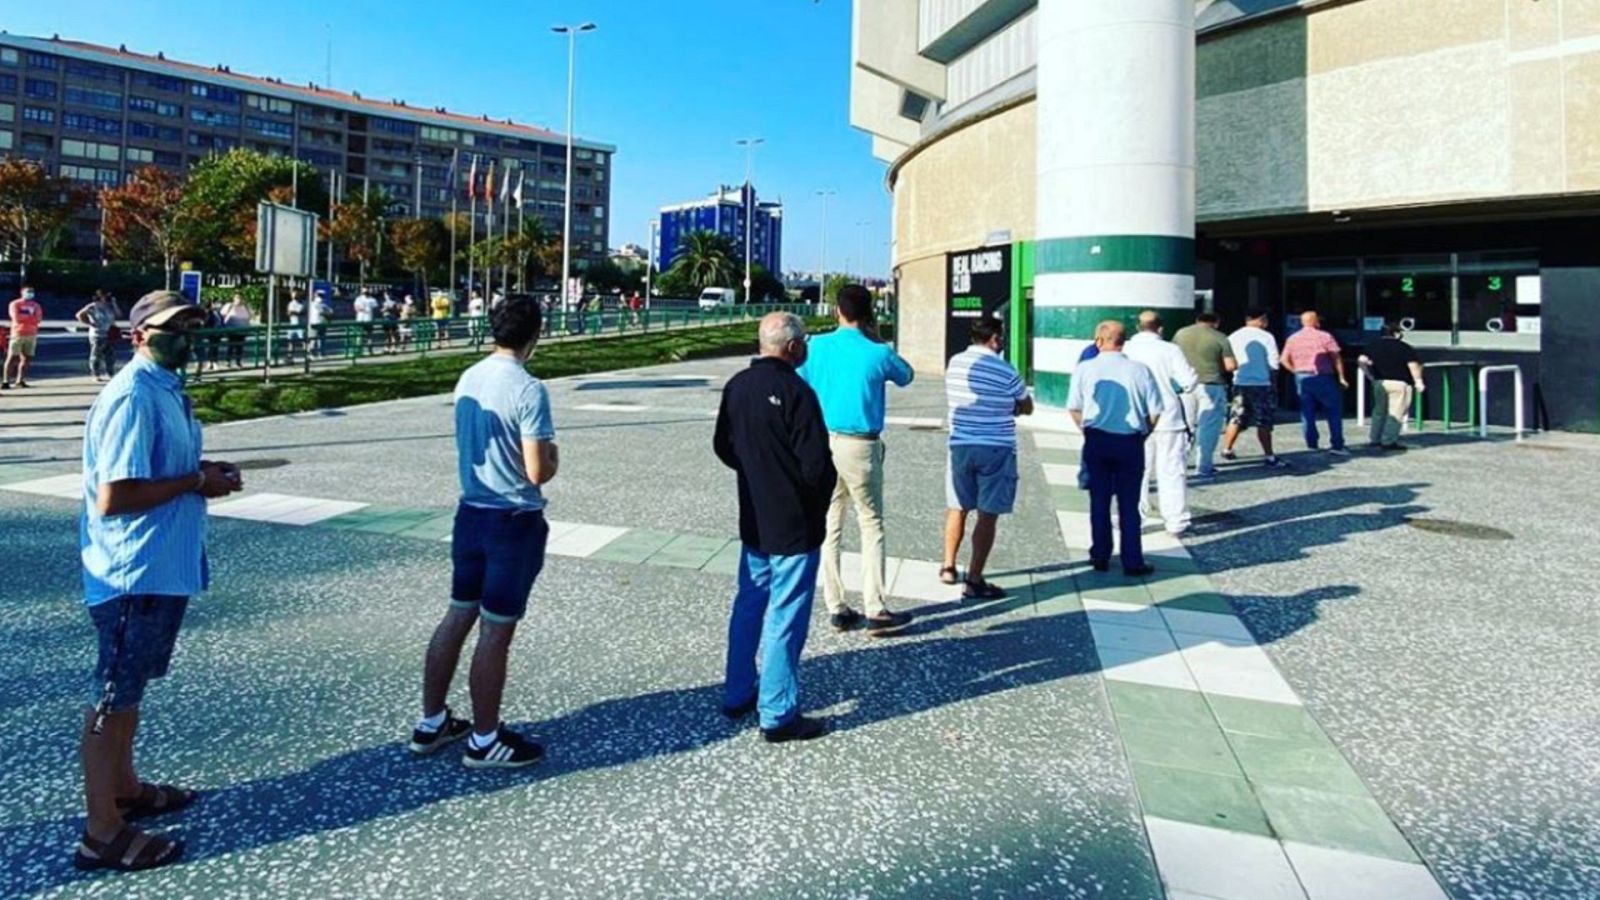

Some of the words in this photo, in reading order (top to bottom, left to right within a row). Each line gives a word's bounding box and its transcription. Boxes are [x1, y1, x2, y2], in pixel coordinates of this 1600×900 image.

[952, 255, 970, 275] REAL
[971, 250, 1002, 273] RACING
[952, 272, 971, 294] CLUB
[1402, 278, 1414, 292] 2
[1488, 276, 1501, 290] 3
